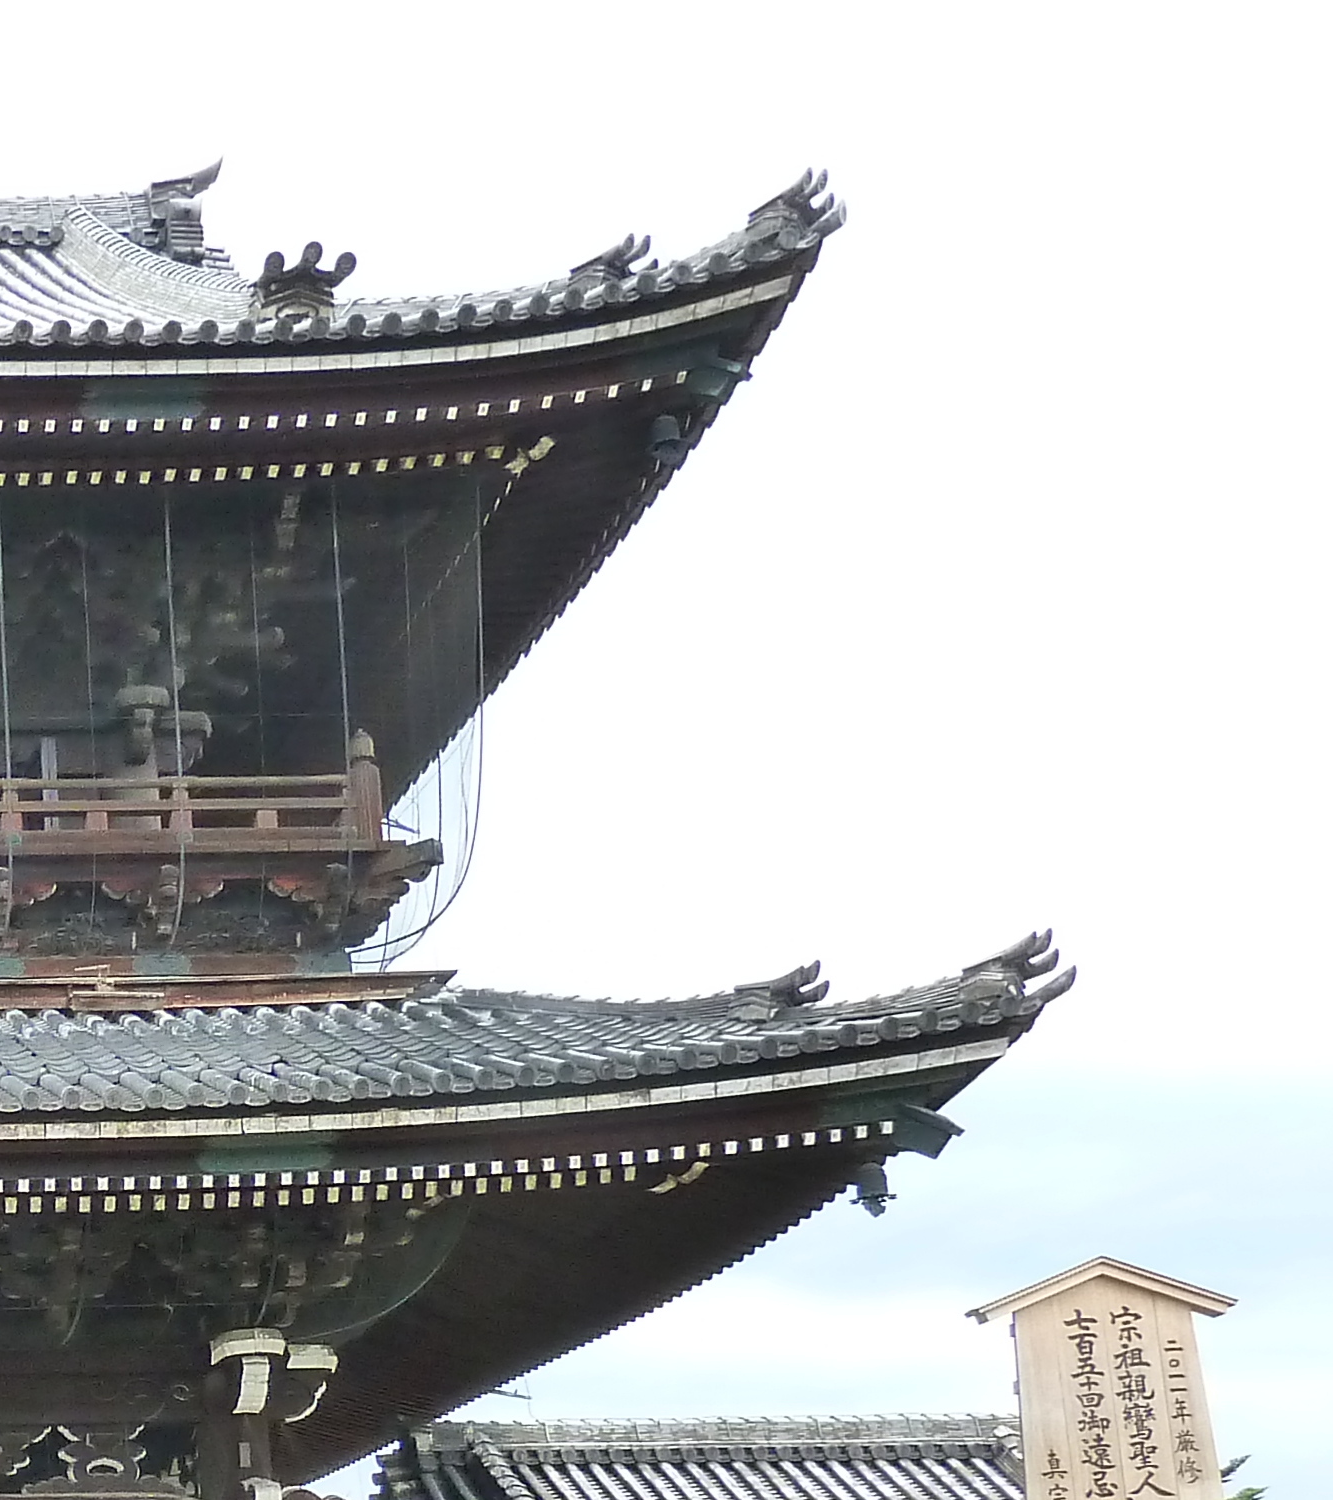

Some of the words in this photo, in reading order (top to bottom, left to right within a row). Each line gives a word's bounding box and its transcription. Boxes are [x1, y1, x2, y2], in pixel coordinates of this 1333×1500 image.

[1063, 1308, 1119, 1499] 七百五十回御遠忌
[1109, 1305, 1176, 1497] 宗祖親鸞聖人
